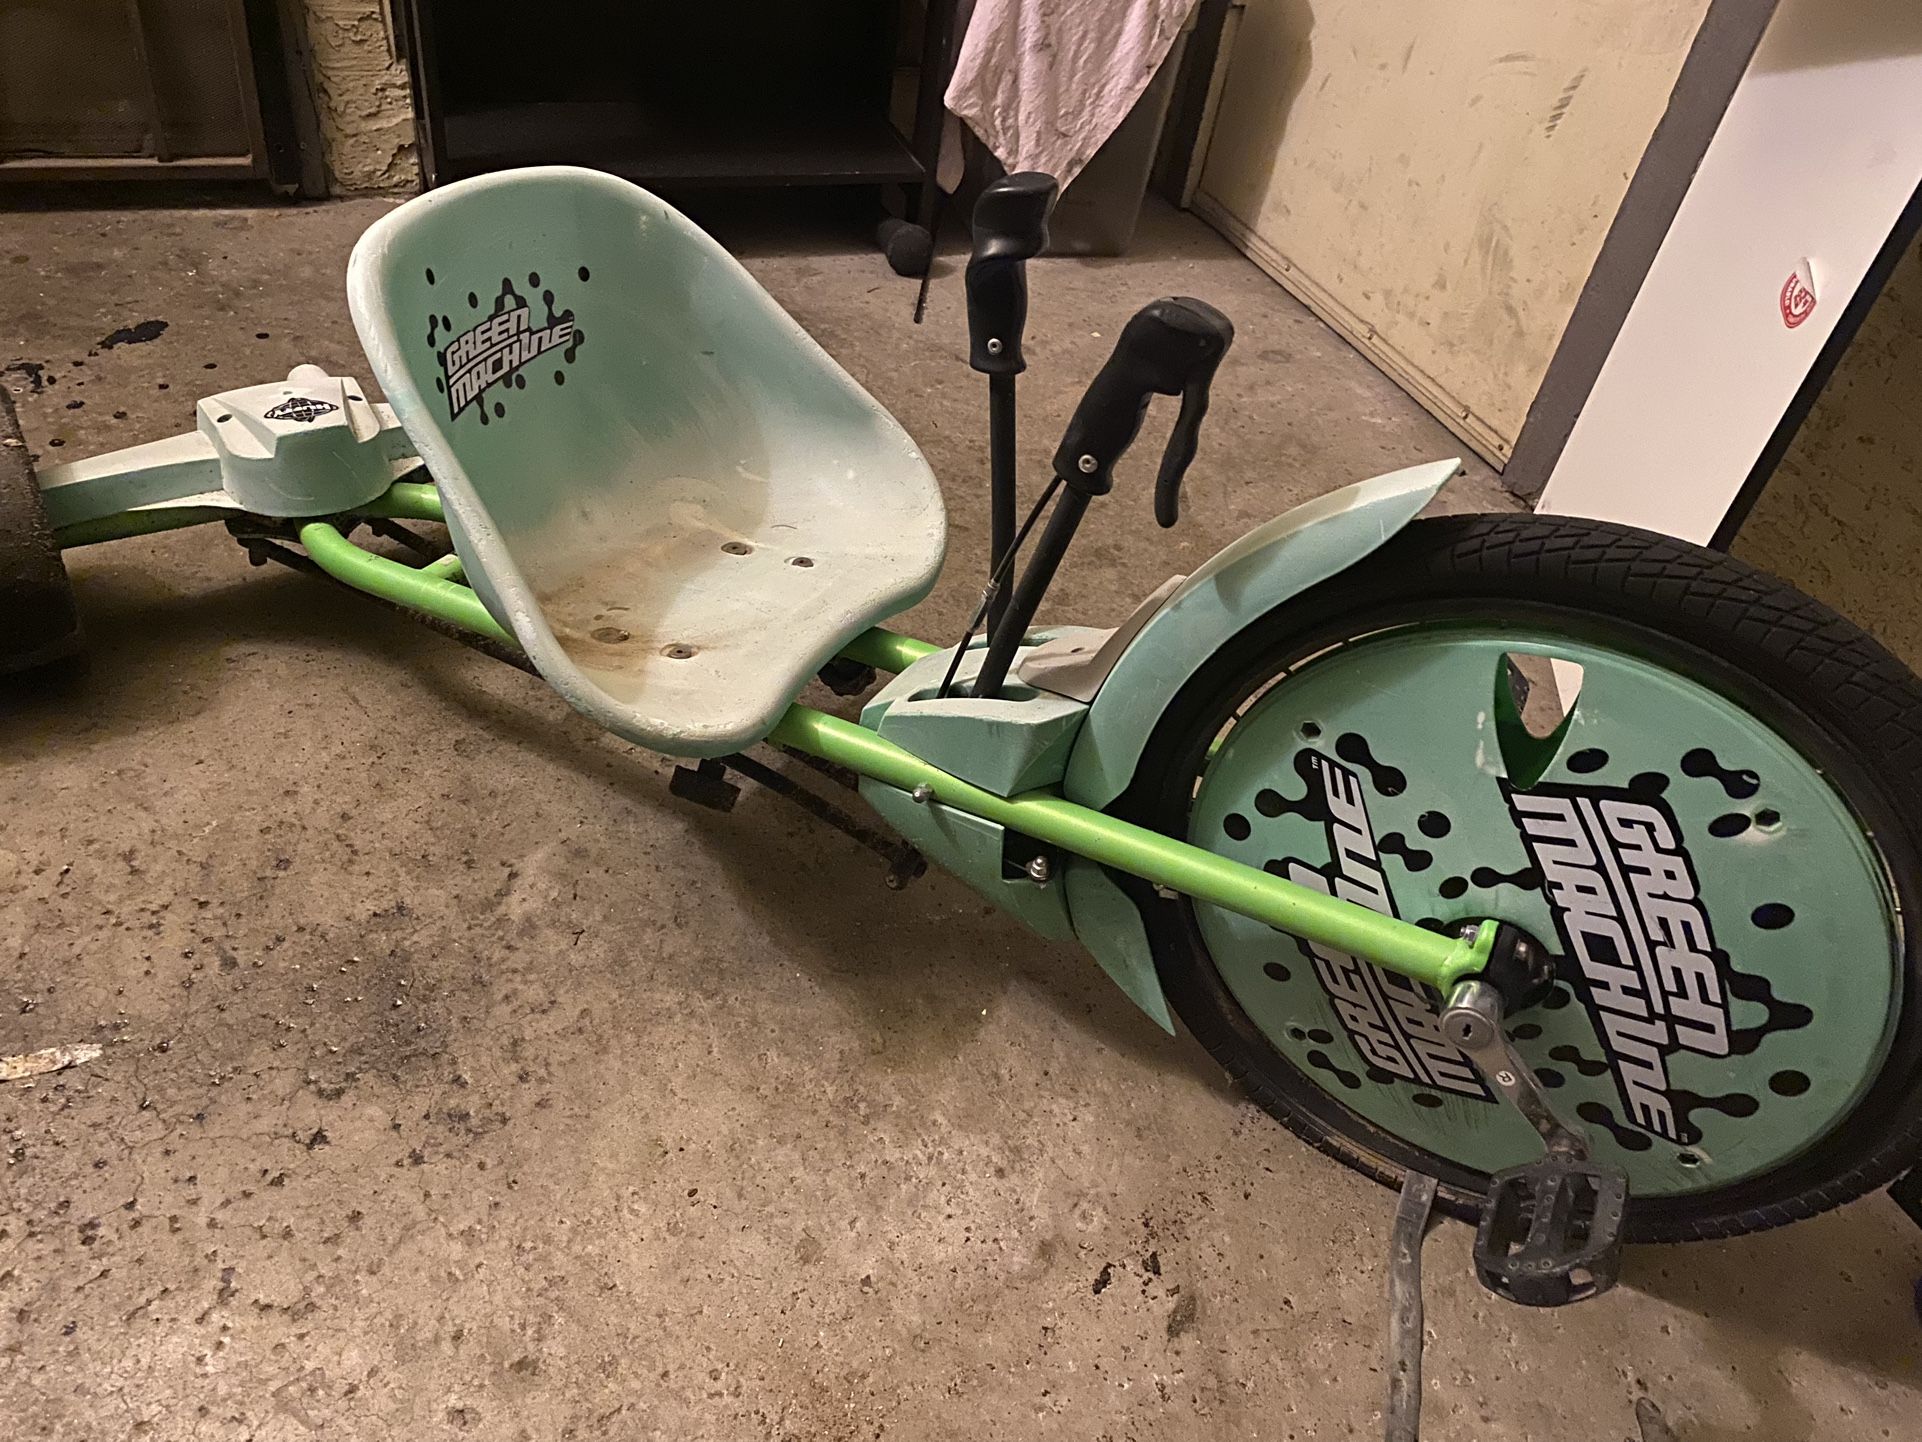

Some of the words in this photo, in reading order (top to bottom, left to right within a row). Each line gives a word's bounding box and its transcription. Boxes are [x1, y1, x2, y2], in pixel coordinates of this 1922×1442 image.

[446, 306, 530, 376] GREEN
[451, 320, 574, 414] MACHINE
[1288, 862, 1415, 1079] GRE
[1321, 759, 1486, 1096] MACINE
[1511, 794, 1677, 1140] MACHINE
[1599, 799, 1729, 1055] GREEN
